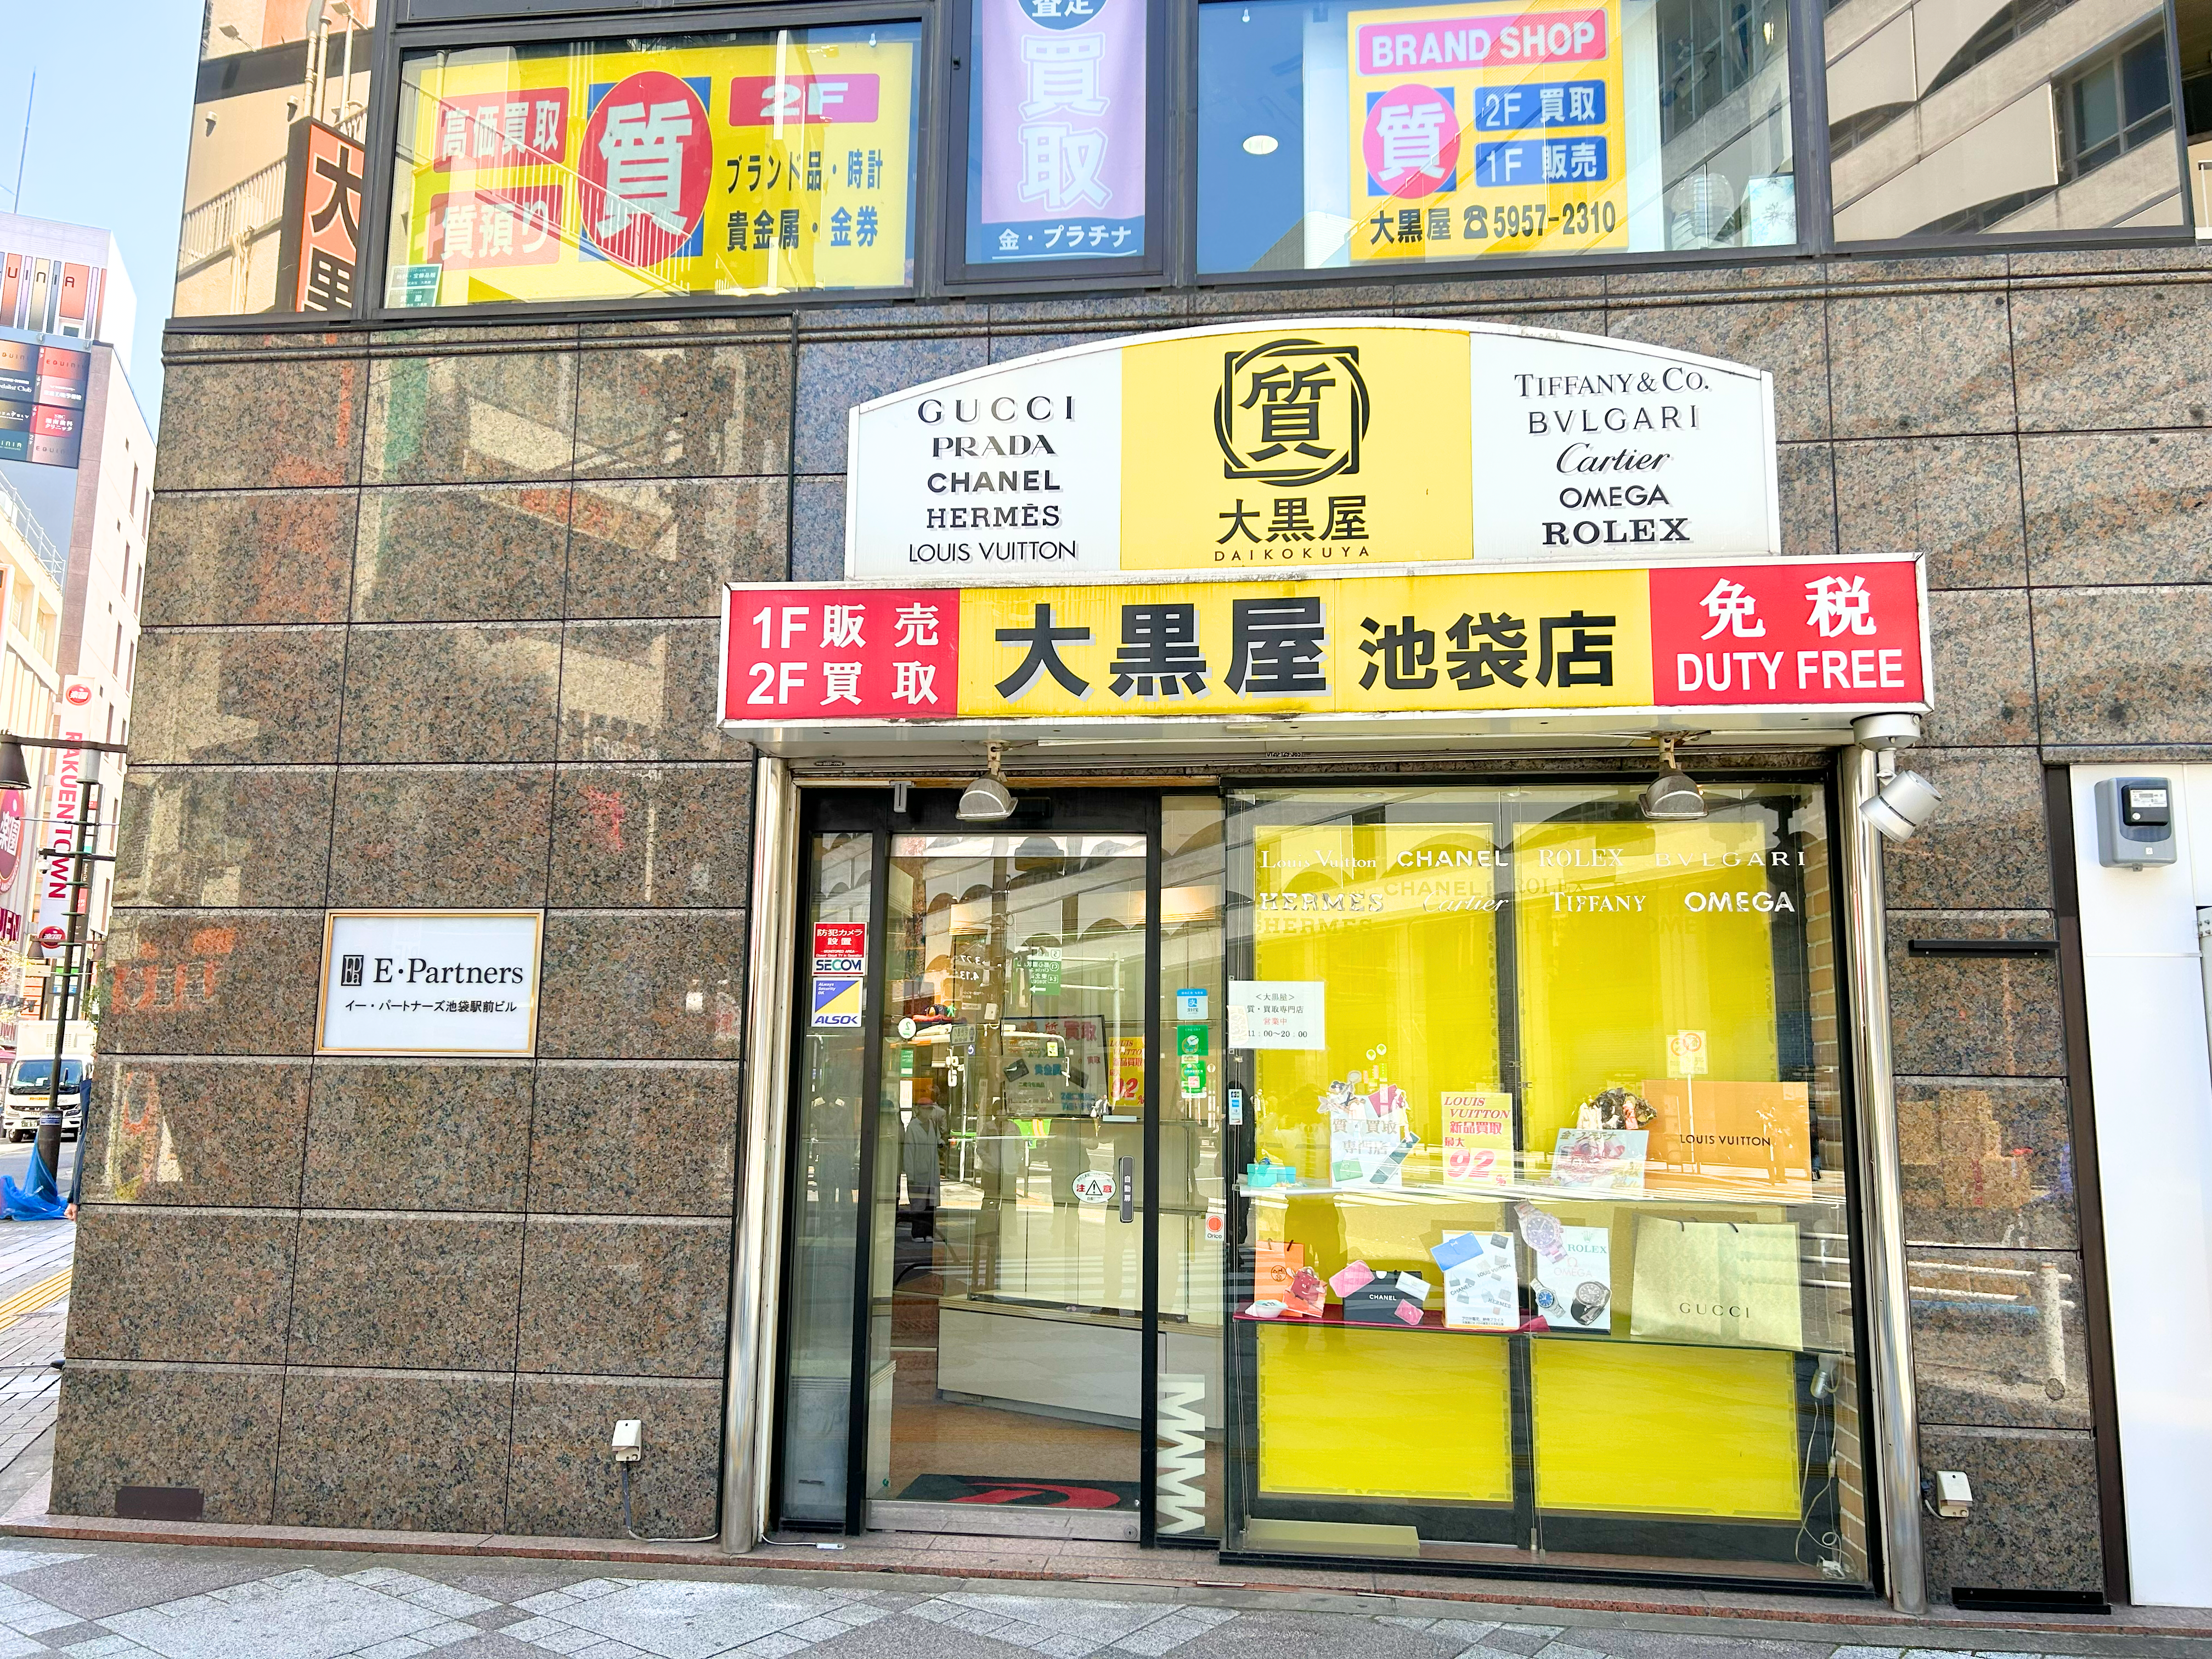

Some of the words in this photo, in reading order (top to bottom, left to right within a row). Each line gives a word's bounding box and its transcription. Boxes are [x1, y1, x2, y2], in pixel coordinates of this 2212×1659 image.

[1372, 29, 1491, 69] BRAND
[1500, 21, 1595, 60] SHOP
[760, 82, 848, 117] 2F
[1485, 92, 1521, 127] 2F
[1540, 87, 1596, 124] 買取
[441, 99, 559, 160] 高価買取
[1019, 33, 1112, 211] 買取
[1376, 101, 1446, 182] 質
[597, 99, 693, 239] 質
[727, 149, 883, 194] ブランド品・時計
[1486, 148, 1522, 183] 1F
[1541, 142, 1597, 179] 販売
[441, 200, 549, 261] 質預り
[727, 205, 879, 252] 貴金属・金券
[1369, 207, 1451, 245] 大黒屋
[1494, 201, 1615, 238] 5957-2310
[999, 224, 1131, 250] 金・プラチナ
[0, 267, 75, 288] UINIA
[918, 396, 1073, 424] GUCCI
[1238, 362, 1336, 461] 質
[1529, 405, 1696, 434] BVLGARI
[933, 435, 1056, 457] PRADA
[1556, 443, 1670, 473] Cartier
[928, 470, 1060, 493] CHANEL
[1560, 484, 1669, 508] OMEGA
[1216, 495, 1369, 544] 大黒屋
[1542, 518, 1690, 545] ROLEX
[910, 543, 970, 562] LOUIS
[979, 540, 1076, 561] VUITTON
[1215, 546, 1369, 561] DAIKOKUYA
[1699, 575, 1876, 641] 免税
[994, 596, 1328, 700] 大黒屋
[1358, 611, 1616, 691] 池袋店
[1677, 651, 1784, 692] DUTY
[1792, 650, 1904, 690] FREE
[1261, 850, 1310, 868] Louis
[1314, 849, 1376, 868] Vuitton
[1397, 850, 1509, 867] CHANEL
[1538, 848, 1624, 867] ROLEX
[1656, 851, 1805, 867] BVLGARI
[1260, 892, 1384, 912] HERMES
[1423, 890, 1510, 912] Cartier
[1550, 892, 1646, 912] TIFFANY
[1684, 891, 1795, 912] OMEGA
[816, 959, 861, 970] SECOM
[345, 1000, 517, 1013] イー・パートナーズ池袋駅前ビル
[815, 1015, 858, 1024] ALSOK
[1247, 1005, 1304, 1014] 質・買取専門店
[1263, 1017, 1288, 1025] 営業中
[1444, 1097, 1486, 1106] LOUIS
[1451, 1109, 1511, 1119] VUITTON
[1450, 1121, 1502, 1135] 新品買取
[1680, 1134, 1715, 1144] LOUIS
[1718, 1135, 1771, 1147] VUITTON
[1444, 1137, 1465, 1147] 最大
[1567, 1244, 1607, 1254] ROLEX
[1679, 1302, 1750, 1318] GUCCI
